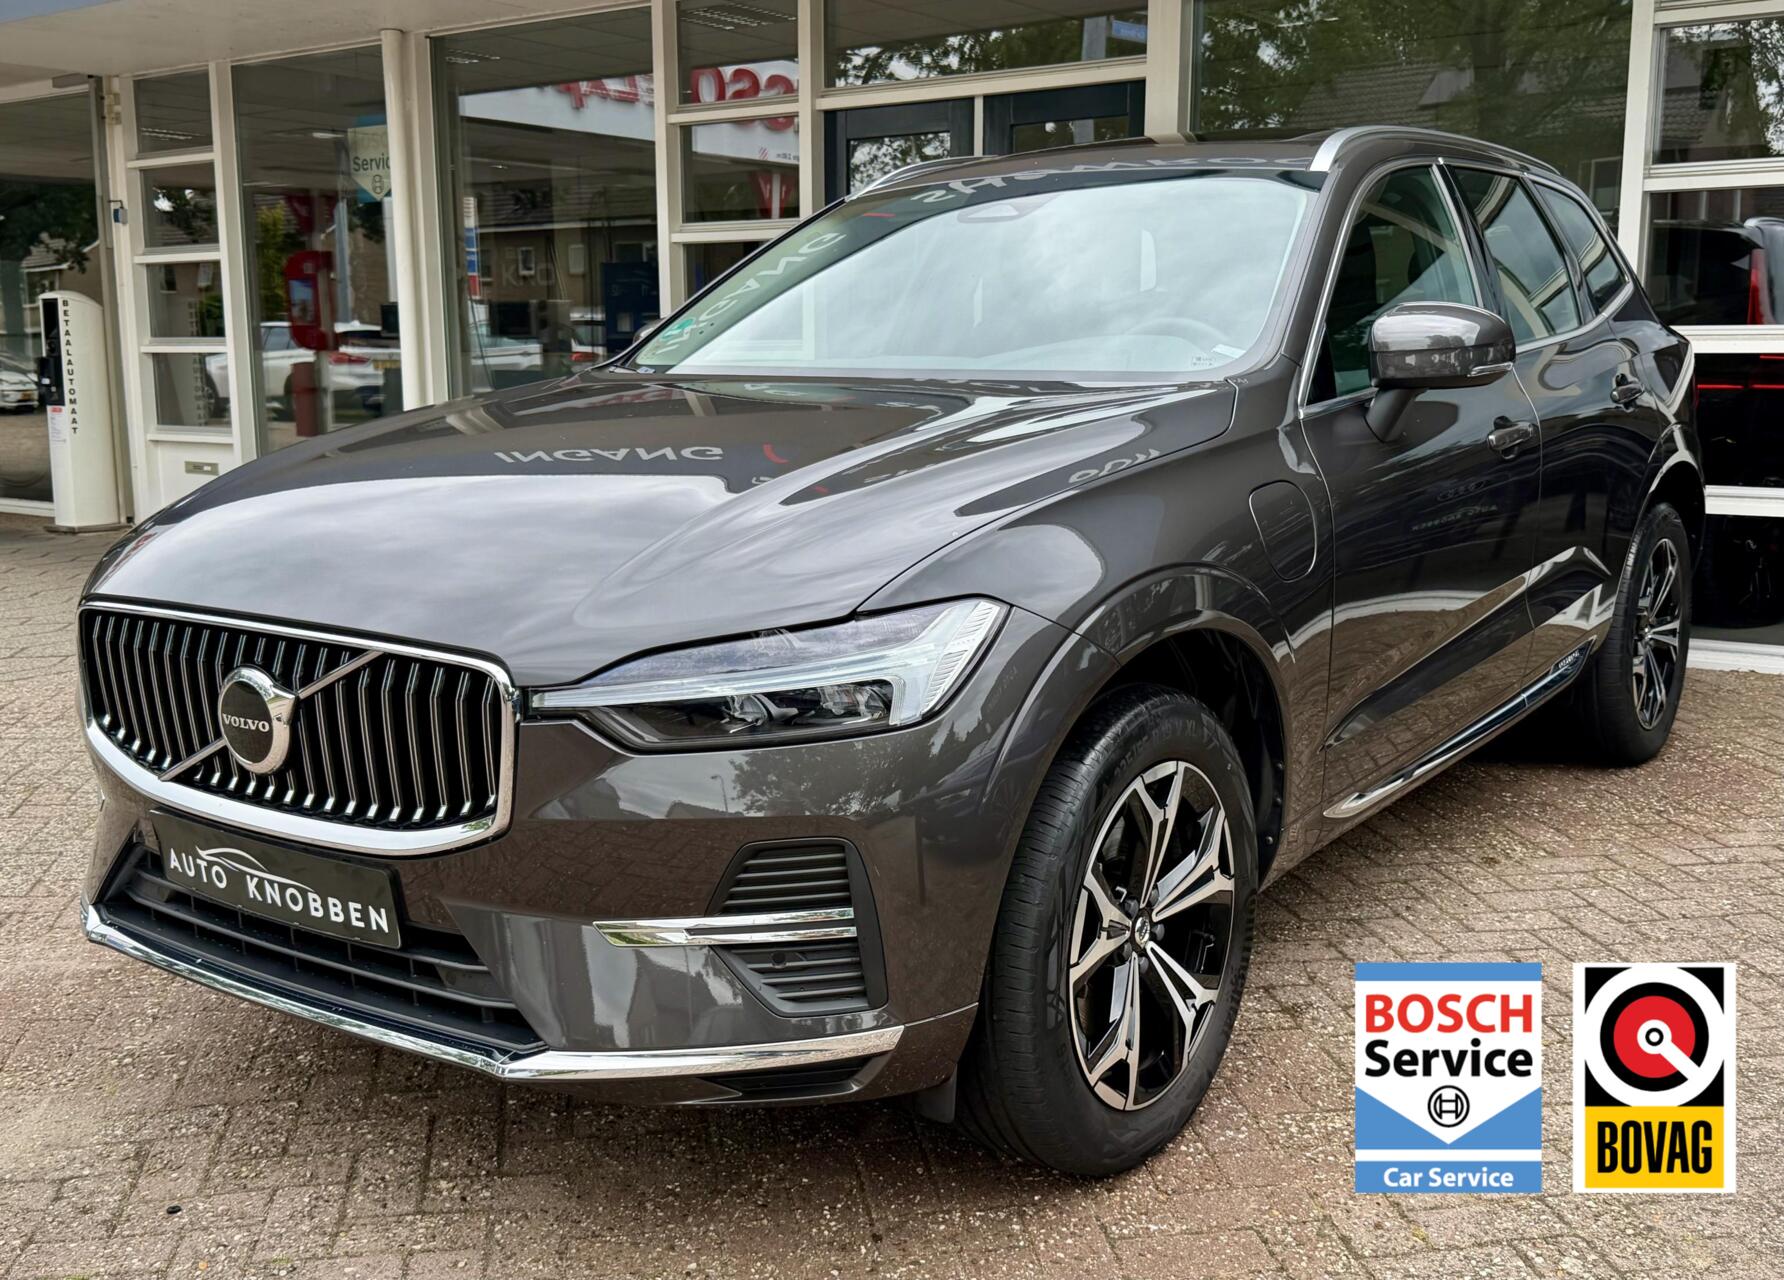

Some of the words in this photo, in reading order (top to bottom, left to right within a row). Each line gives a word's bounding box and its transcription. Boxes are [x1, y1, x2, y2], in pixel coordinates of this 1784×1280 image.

[62, 299, 79, 434] BETAALAUTOMAAT
[222, 713, 270, 733] VOLVO
[169, 848, 228, 889] AUTO
[246, 874, 390, 934] KNOBBEN
